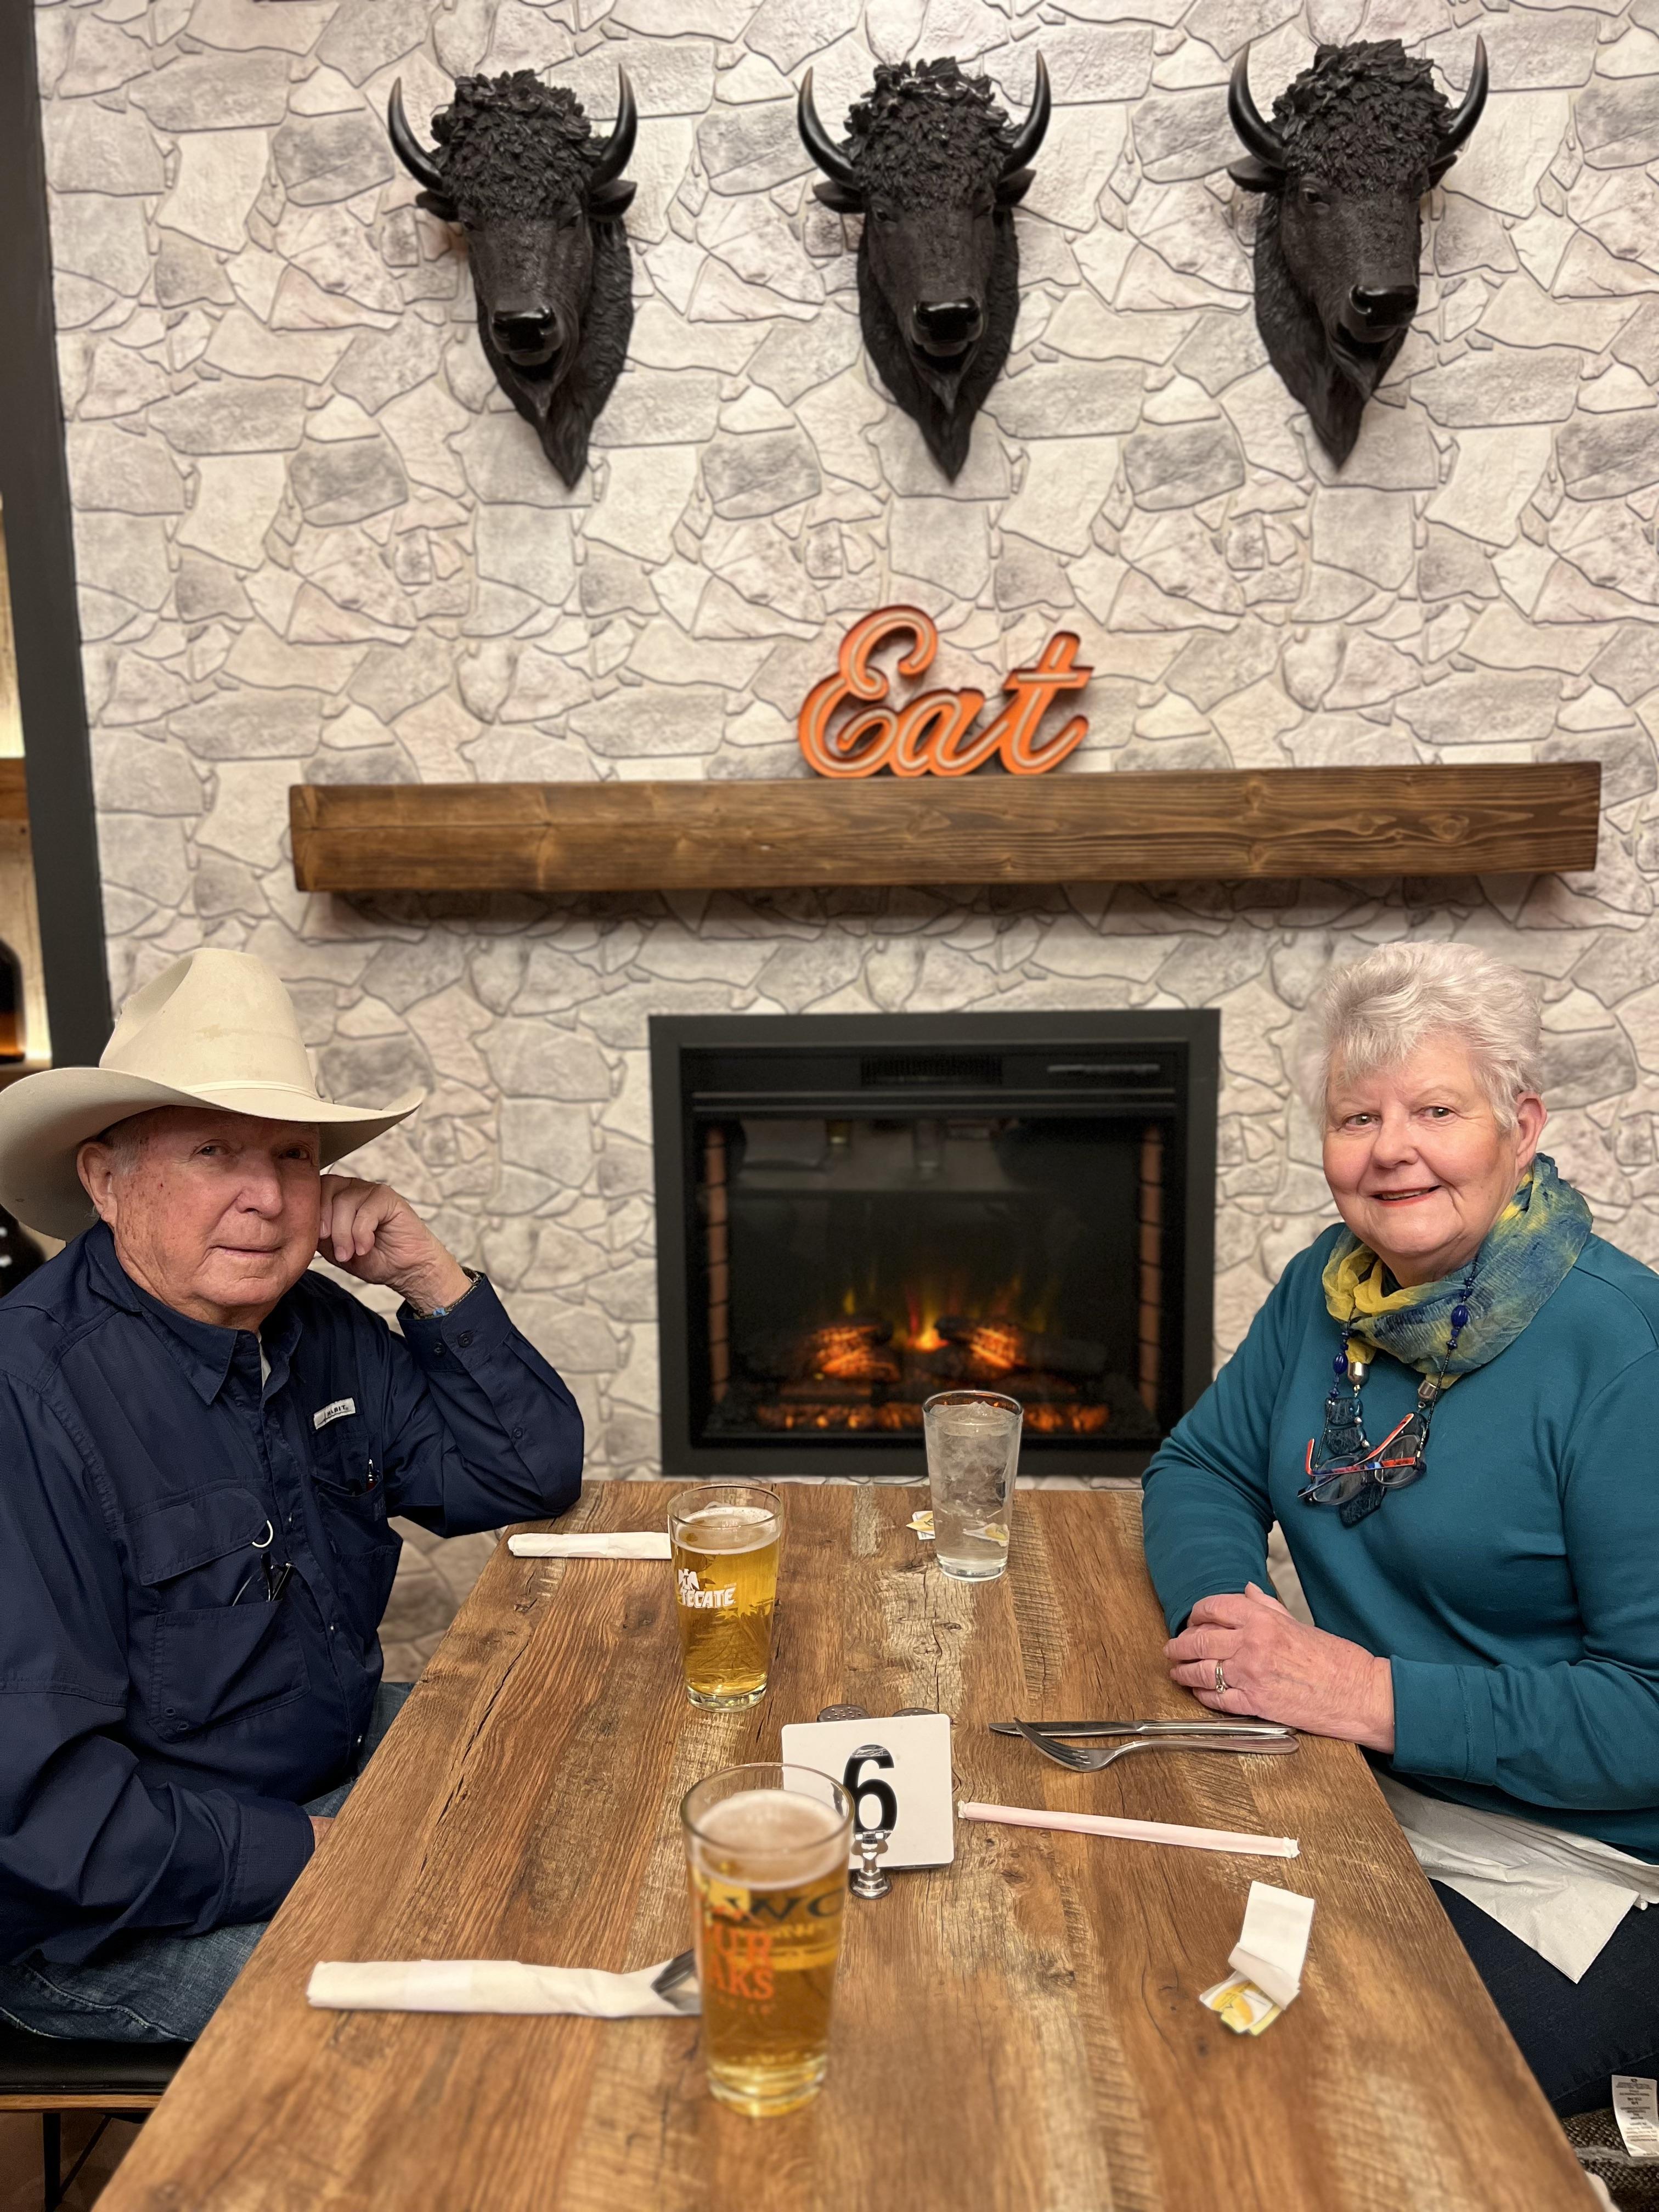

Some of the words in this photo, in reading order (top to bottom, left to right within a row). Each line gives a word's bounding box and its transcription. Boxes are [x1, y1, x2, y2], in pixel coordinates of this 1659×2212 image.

[798, 605, 1094, 778] Eat
[680, 1586, 737, 1608] TECATE
[843, 1744, 898, 1845] 6
